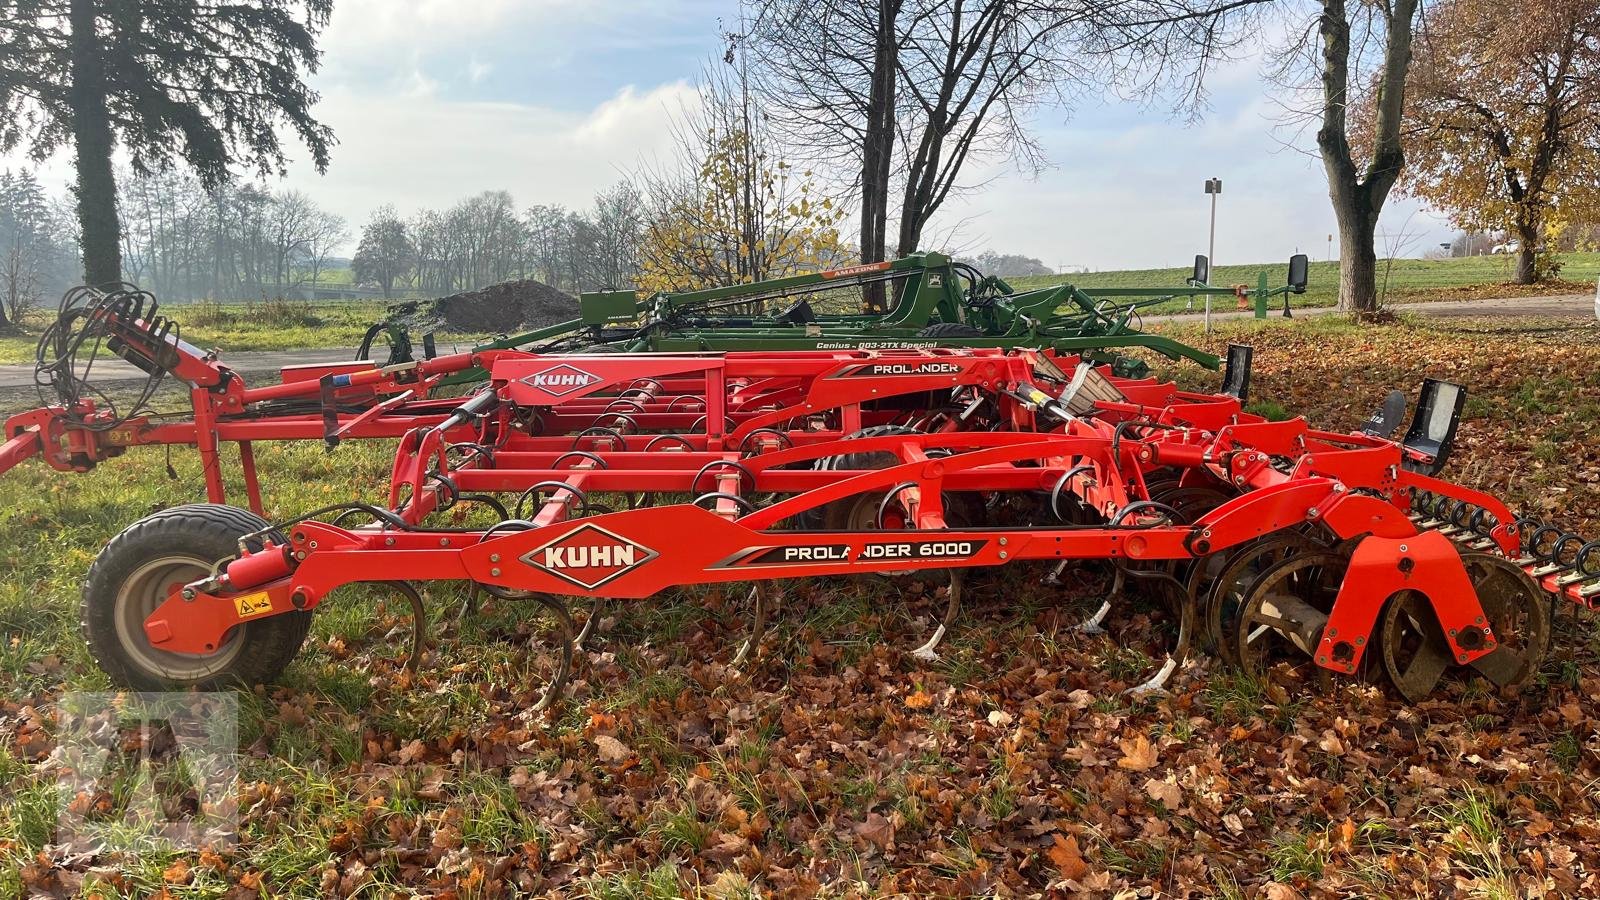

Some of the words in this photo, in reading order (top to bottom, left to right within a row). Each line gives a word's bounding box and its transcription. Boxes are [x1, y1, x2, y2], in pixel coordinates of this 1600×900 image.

[834, 264, 880, 277] AMAZONE
[900, 341, 938, 350] Special
[534, 374, 589, 386] KUHN
[545, 544, 634, 568] KUHN
[919, 543, 972, 556] 6000
